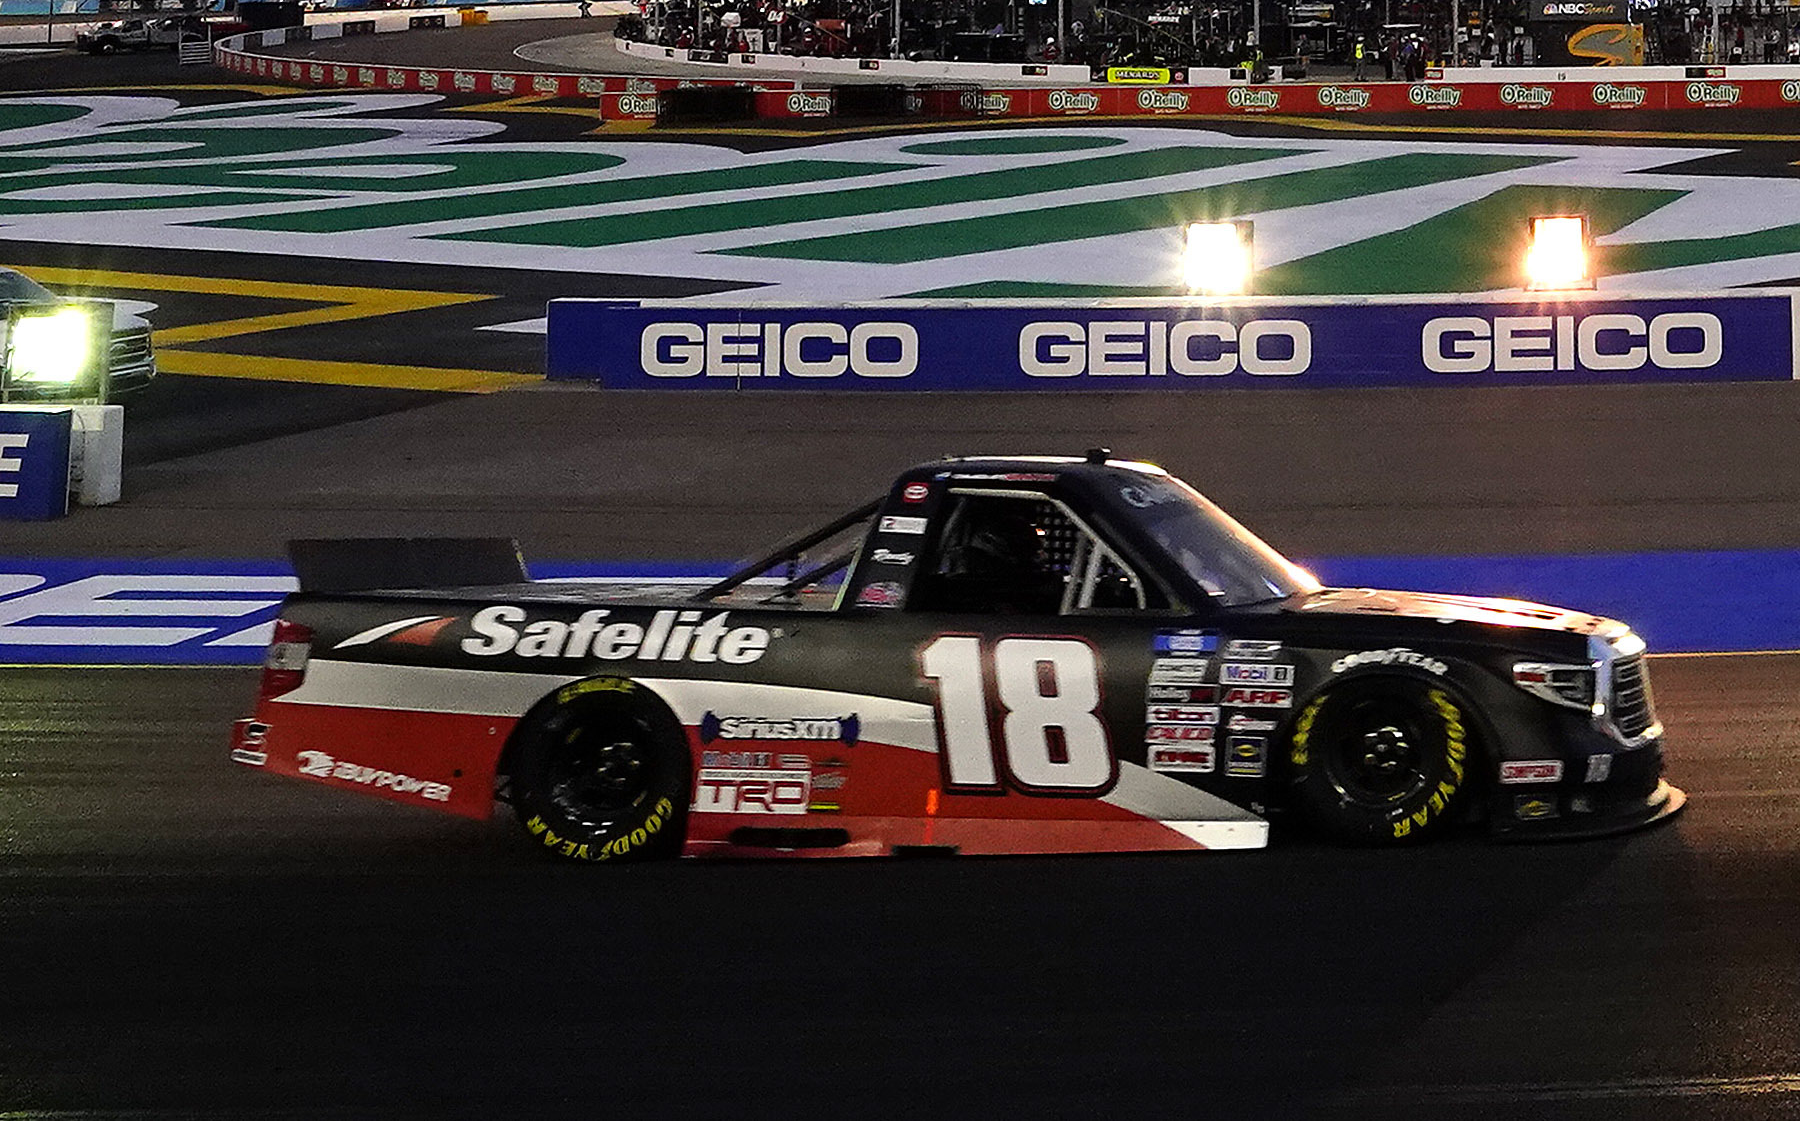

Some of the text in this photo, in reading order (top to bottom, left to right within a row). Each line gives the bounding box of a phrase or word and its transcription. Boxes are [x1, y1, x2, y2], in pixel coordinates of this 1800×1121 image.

[1558, 5, 1584, 14] NBC
[1115, 69, 1161, 80] MENARDS
[1050, 90, 1098, 111] O'Reilly
[1138, 88, 1188, 110] O'Reilly
[1227, 86, 1279, 108] O'Reilly
[1318, 85, 1370, 108] O'Reilly
[1408, 84, 1461, 107] O'Reilly
[1500, 83, 1552, 105] O'Reilly
[1592, 82, 1645, 105] O'Reilly
[1686, 81, 1740, 104] O'Reilly
[640, 322, 919, 378] GEICO
[1019, 319, 1312, 377] GEICO
[1421, 312, 1723, 373] GEICO
[461, 606, 770, 664] Safelite
[920, 634, 1115, 793] 18
